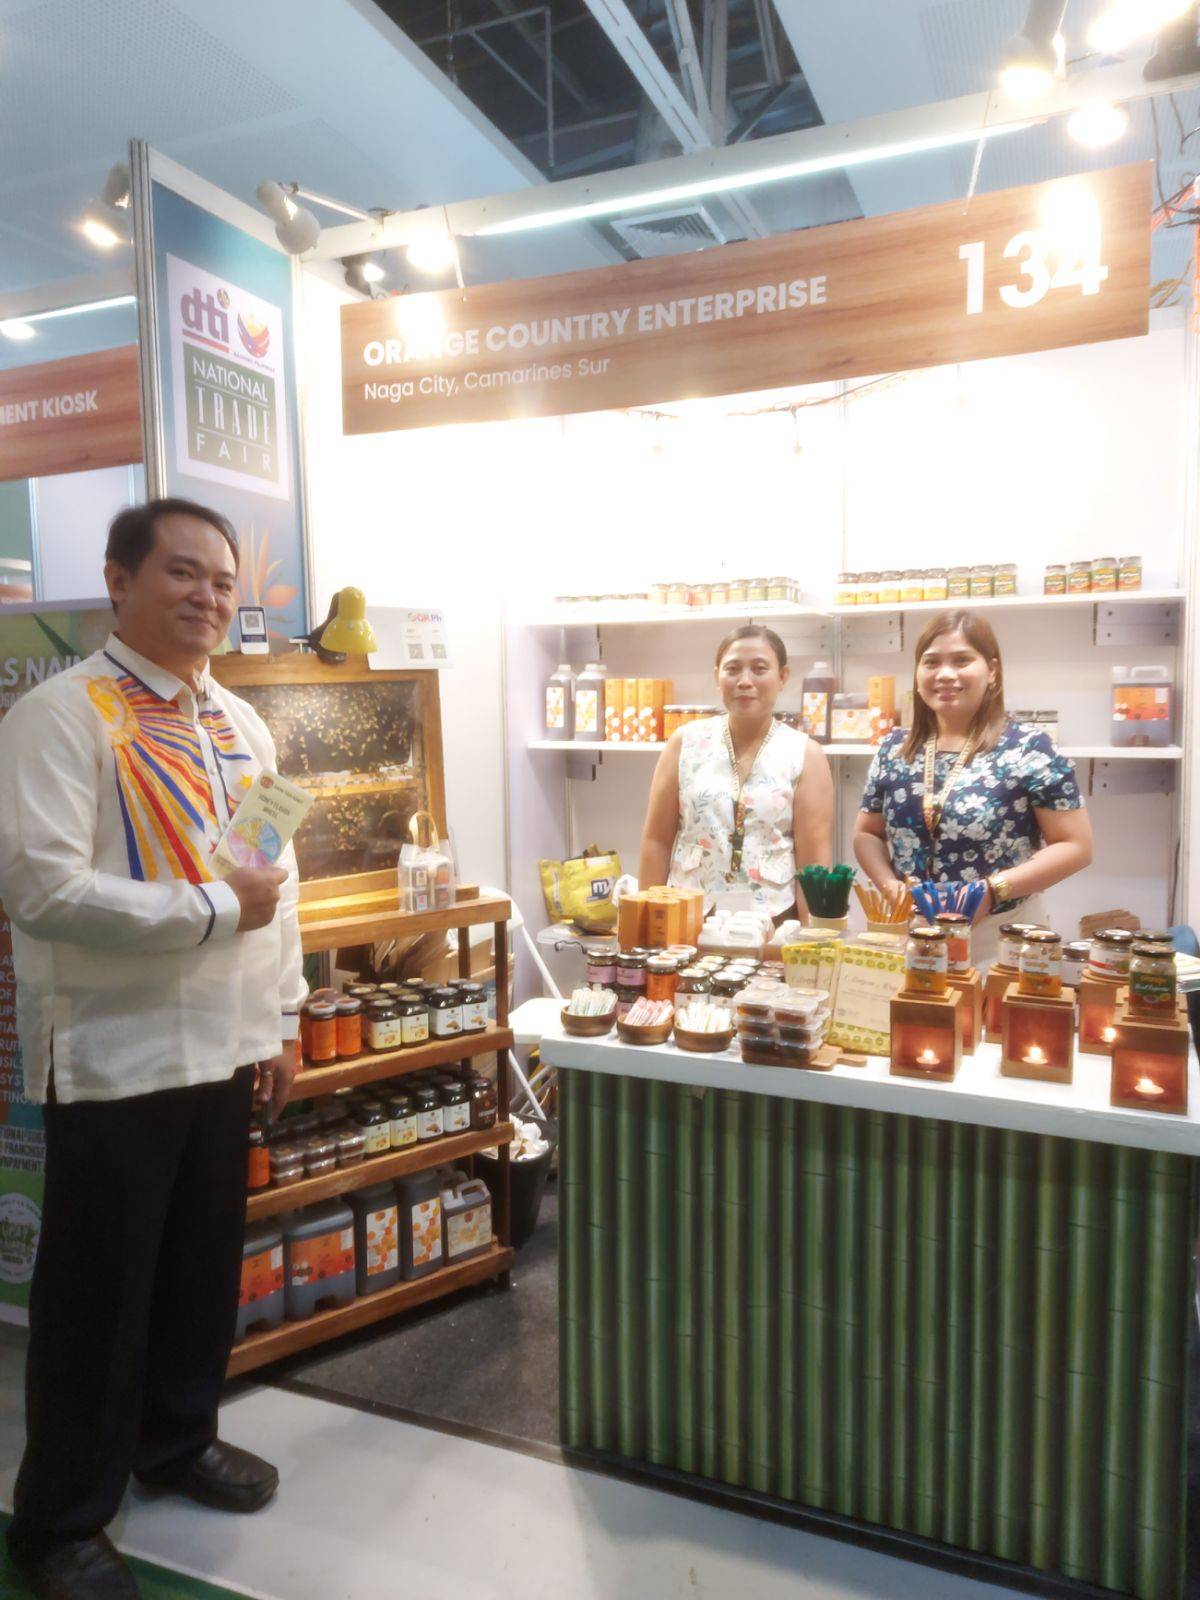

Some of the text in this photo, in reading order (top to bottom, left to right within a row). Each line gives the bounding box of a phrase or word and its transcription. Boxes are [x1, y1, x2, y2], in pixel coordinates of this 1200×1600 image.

[957, 228, 1109, 317] 134
[181, 287, 230, 344] dti
[486, 310, 629, 352] COUNTRY
[637, 275, 827, 333] ENTERPRISE
[42, 389, 98, 419] KIOSK
[192, 357, 268, 402] NATIONAL
[364, 358, 610, 403] Naga City, Camarines Sur
[196, 385, 270, 446] TRADE
[196, 432, 272, 474] FAIR
